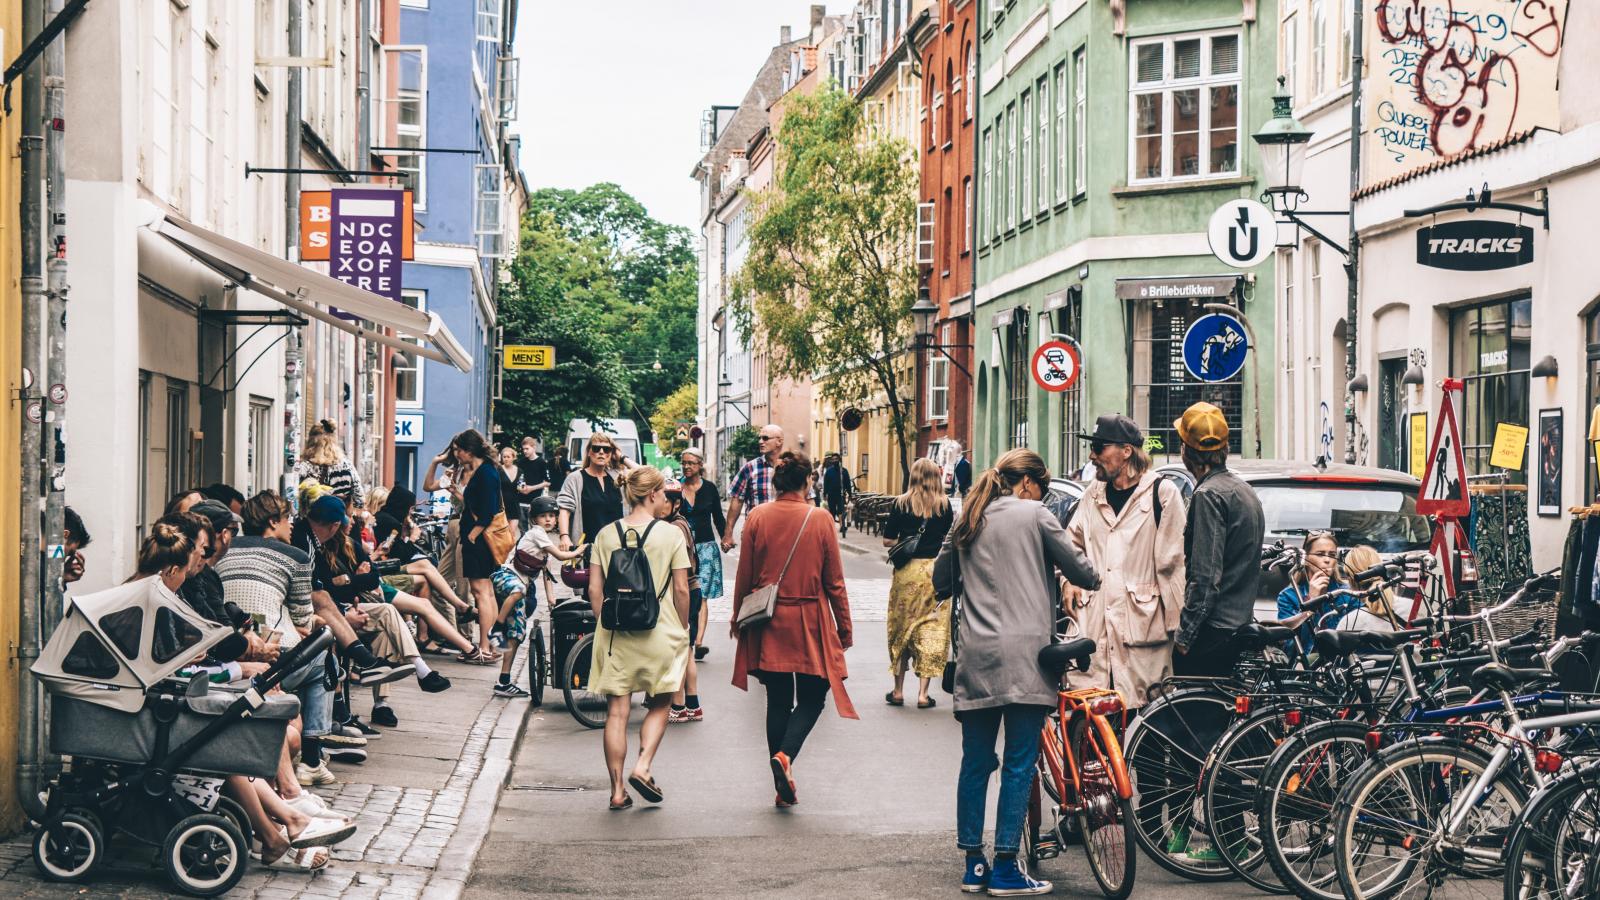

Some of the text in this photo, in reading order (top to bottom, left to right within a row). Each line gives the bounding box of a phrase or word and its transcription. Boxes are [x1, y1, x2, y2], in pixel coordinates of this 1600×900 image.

[1428, 237, 1523, 254] TRACKS
[1149, 284, 1215, 297] Brillebutikken
[512, 353, 542, 363] MEN'S
[1481, 350, 1507, 368] TRACKS
